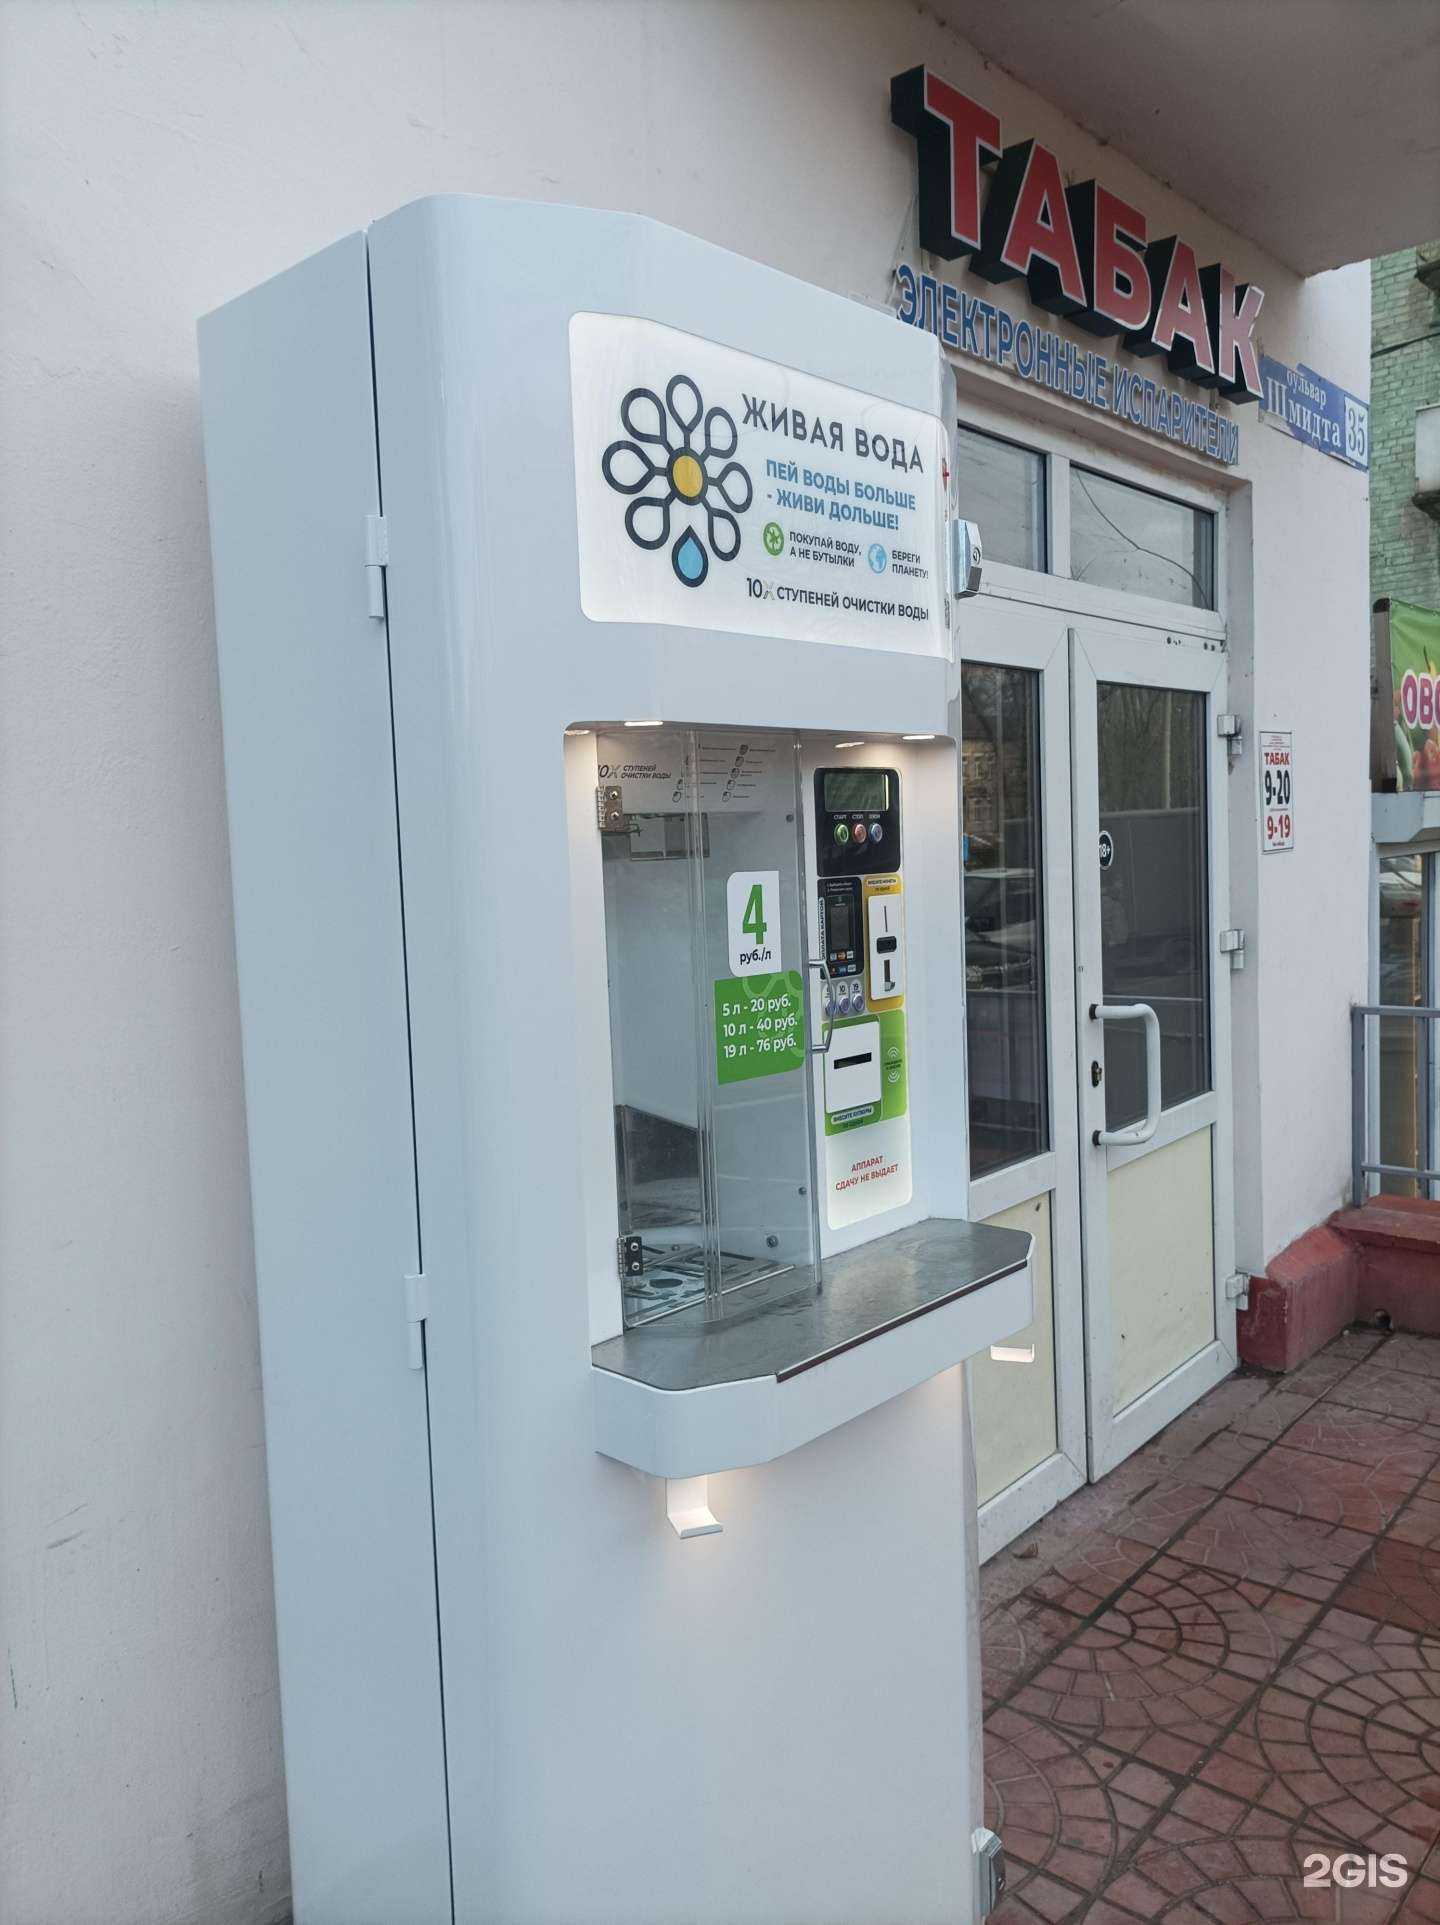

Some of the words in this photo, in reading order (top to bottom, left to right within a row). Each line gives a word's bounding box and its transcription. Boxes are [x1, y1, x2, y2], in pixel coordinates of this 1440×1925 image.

[916, 65, 1265, 400] ТАБАК
[896, 263, 1109, 409] ЭЛЕКТРОННЫЕ
[1112, 363, 1240, 466] ИСПАРИТЕЛИ
[1266, 376, 1342, 448] Шмидта
[741, 393, 844, 452] ЖИВАЯ
[855, 427, 924, 474] ВОДА
[1347, 406, 1367, 457] 35
[765, 458, 799, 484] ПЕЙ
[803, 468, 850, 496] ВОДЫ
[854, 481, 917, 511] БОЛЬШЕ
[776, 488, 826, 516] ЖИВИ
[828, 500, 900, 531] ДОЛЬШЕ!
[789, 531, 834, 550] ПОКУПАЙ
[835, 539, 862, 556] ВОДУ,
[789, 546, 797, 557] А
[798, 549, 811, 561] НЕ
[812, 551, 856, 568] БУТЫЛКИ
[891, 550, 921, 564] БЕРЕГИ
[891, 564, 929, 580] ПЛАНЕТУ!
[776, 586, 840, 609] СТУПЕНЕЙ
[842, 596, 896, 617] ОЧИСТКИ
[899, 604, 930, 622] ВОДЫ
[1263, 751, 1290, 766] ТАБАК
[741, 883, 768, 945] 4
[739, 947, 772, 966] руб./л
[722, 1002, 730, 1017] 5
[733, 1003, 741, 1015] л
[750, 997, 765, 1012] 20
[767, 994, 792, 1010] руб.
[723, 1023, 737, 1038] 10
[738, 1023, 747, 1035] л
[756, 1017, 772, 1032] 40
[774, 1013, 799, 1032] руб.
[724, 1044, 737, 1059] 19
[738, 1044, 747, 1056] л
[756, 1038, 771, 1053] 76
[774, 1033, 798, 1052] руб.
[851, 1155, 884, 1173] АППАРАТ
[835, 1173, 859, 1191] СДАЧУ
[860, 1171, 870, 1183] НЕ
[870, 1164, 899, 1180] ВЫДАЕТ
